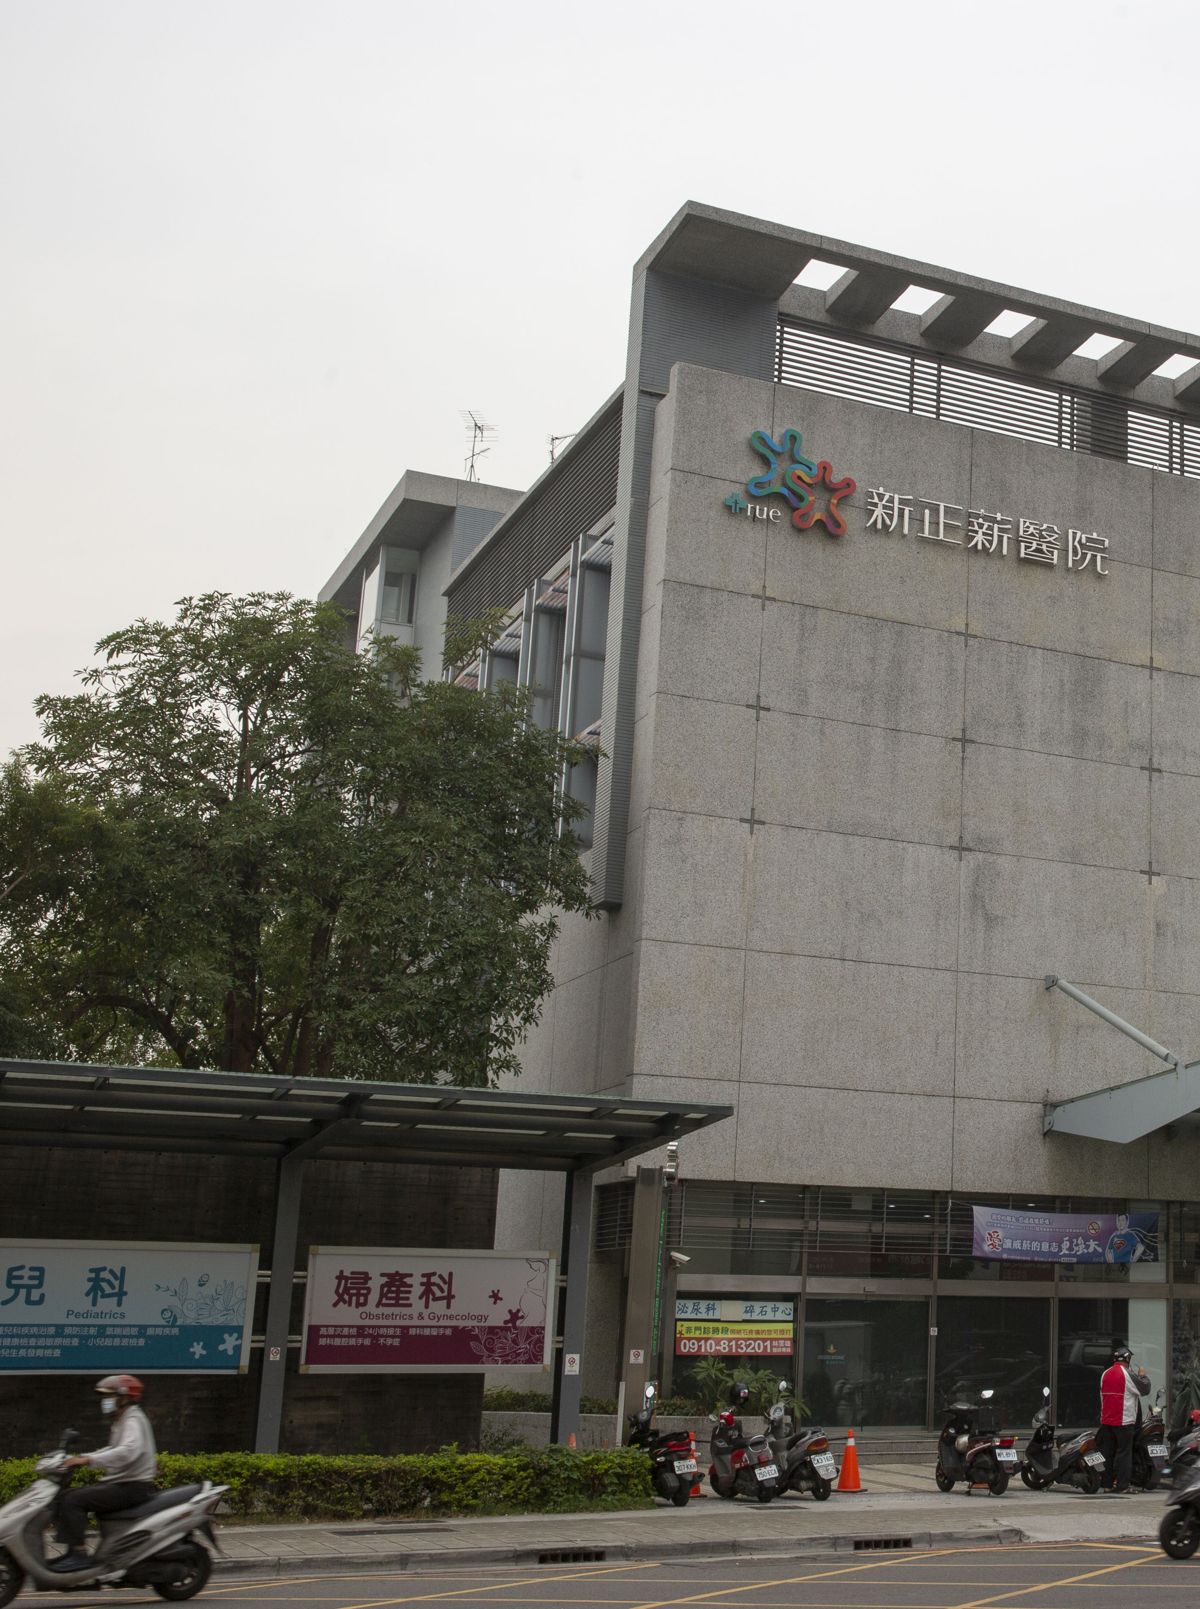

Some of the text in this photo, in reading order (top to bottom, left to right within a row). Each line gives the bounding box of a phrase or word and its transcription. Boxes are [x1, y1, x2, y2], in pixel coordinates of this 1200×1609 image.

[866, 486, 1109, 575] 新正薪醫院
[332, 1269, 455, 1310] 婦產科
[66, 1309, 126, 1320] Pediatrics
[359, 1311, 489, 1323] Obstetrics & Gynecology
[676, 1301, 793, 1318] 泌尿科 碎石中心
[680, 1339, 772, 1353] 0910-813201
